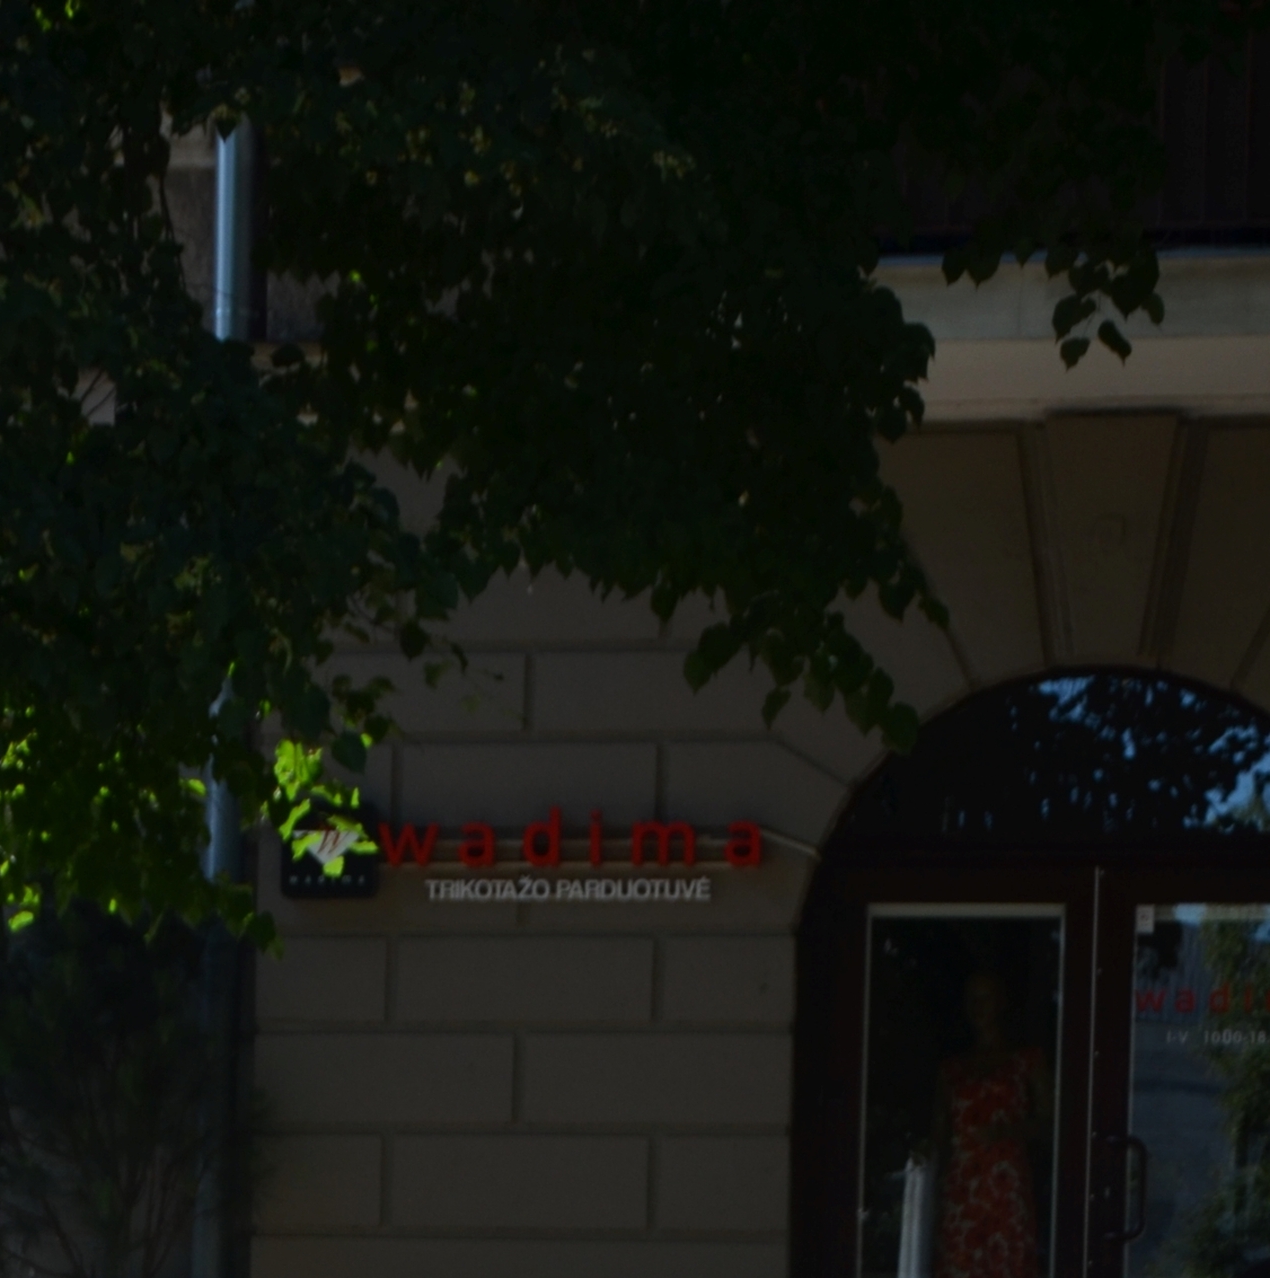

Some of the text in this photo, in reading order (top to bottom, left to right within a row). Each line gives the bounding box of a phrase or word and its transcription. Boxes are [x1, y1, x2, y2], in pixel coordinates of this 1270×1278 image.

[376, 804, 761, 867] wadima
[425, 873, 711, 901] TRIKOTAŽO PARDUOTUVĖ
[1134, 980, 1270, 1013] wadi
